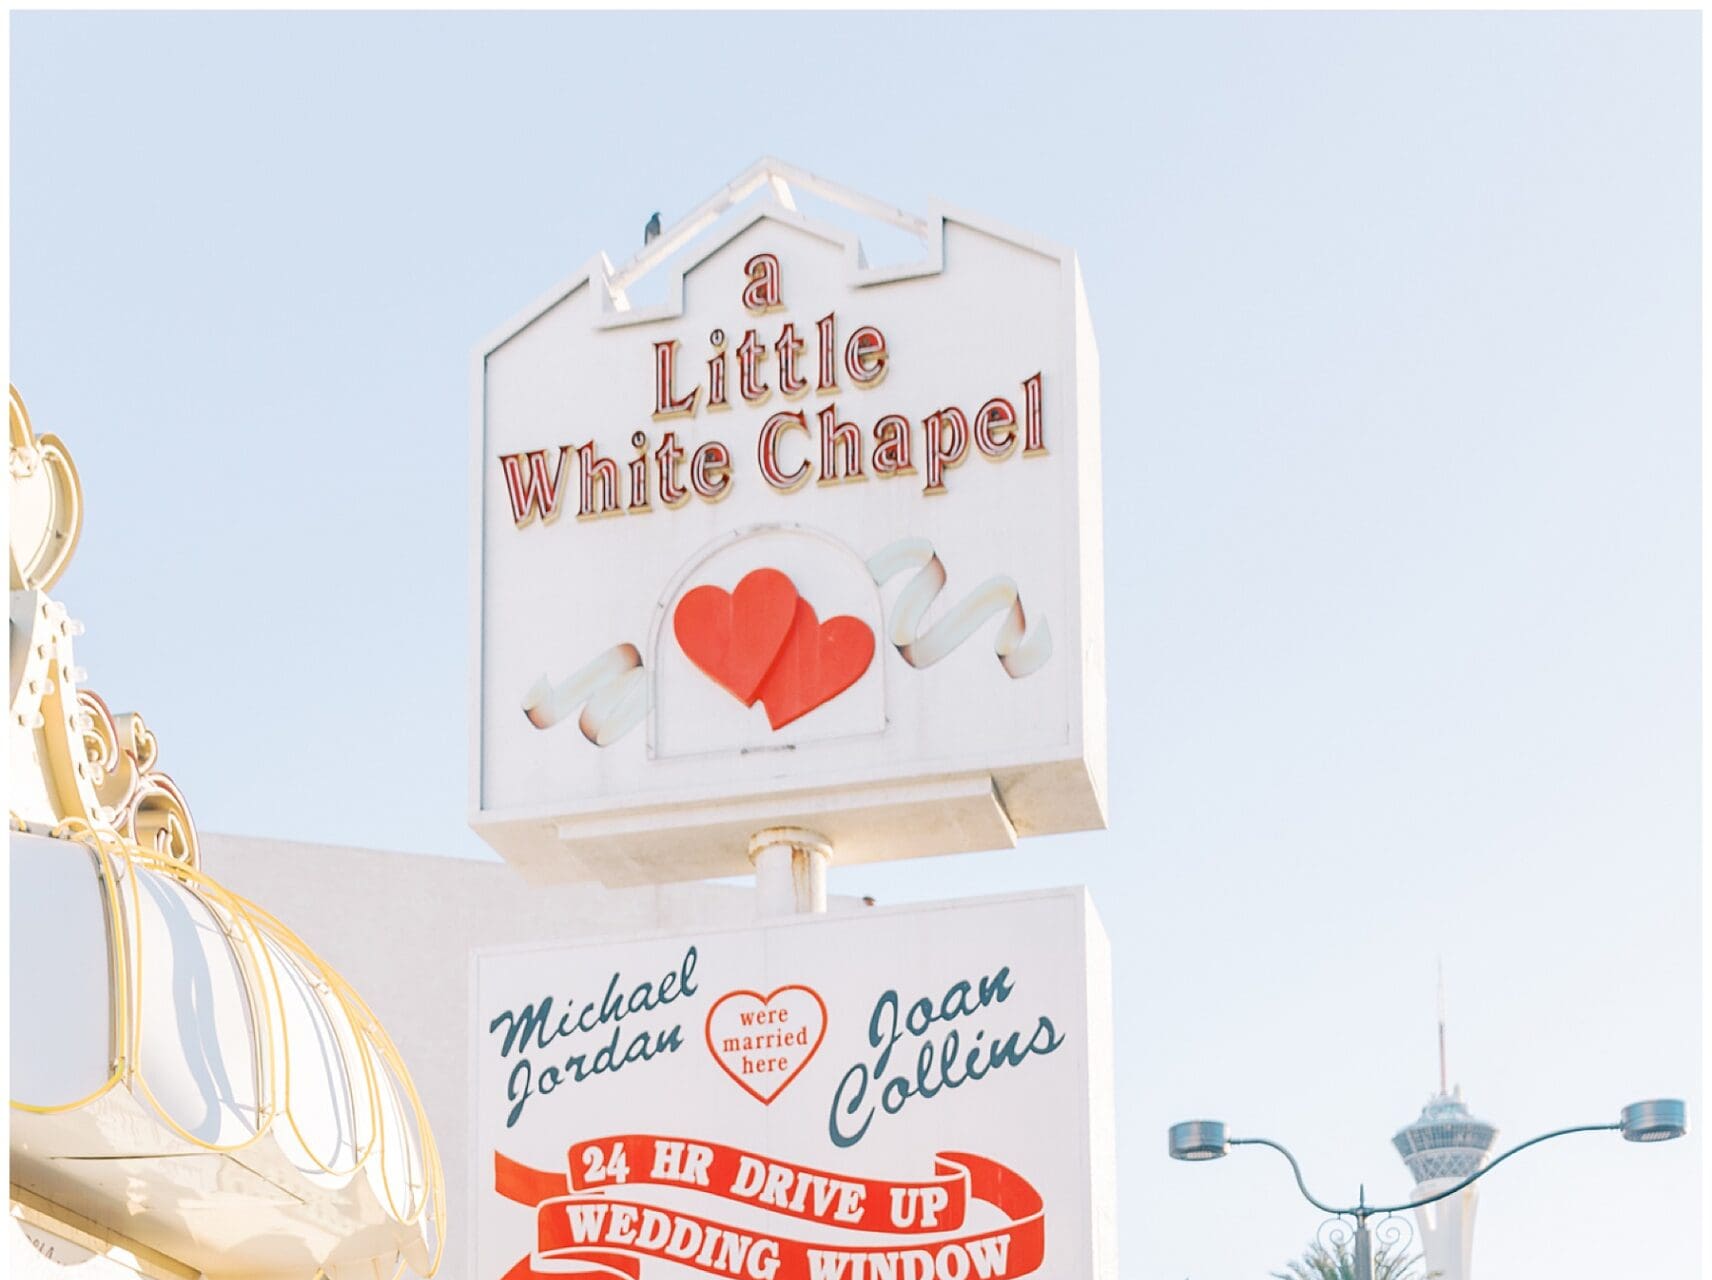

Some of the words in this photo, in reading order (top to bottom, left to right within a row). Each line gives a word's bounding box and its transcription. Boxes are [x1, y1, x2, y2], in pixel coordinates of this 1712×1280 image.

[742, 252, 785, 312] a
[652, 312, 889, 421] Little
[500, 431, 732, 529] White
[758, 371, 1049, 495] Chapel
[489, 946, 699, 1058] Michael
[723, 1028, 808, 1053] married
[740, 1006, 789, 1025] were
[869, 966, 1015, 1079] Joan
[506, 1024, 684, 1128] Jordan
[743, 1054, 788, 1074] here
[829, 1016, 1065, 1148] Collins
[581, 1144, 631, 1184] 24
[652, 1142, 715, 1186] HR
[731, 1157, 866, 1225] DRIVE
[890, 1188, 949, 1228] UP
